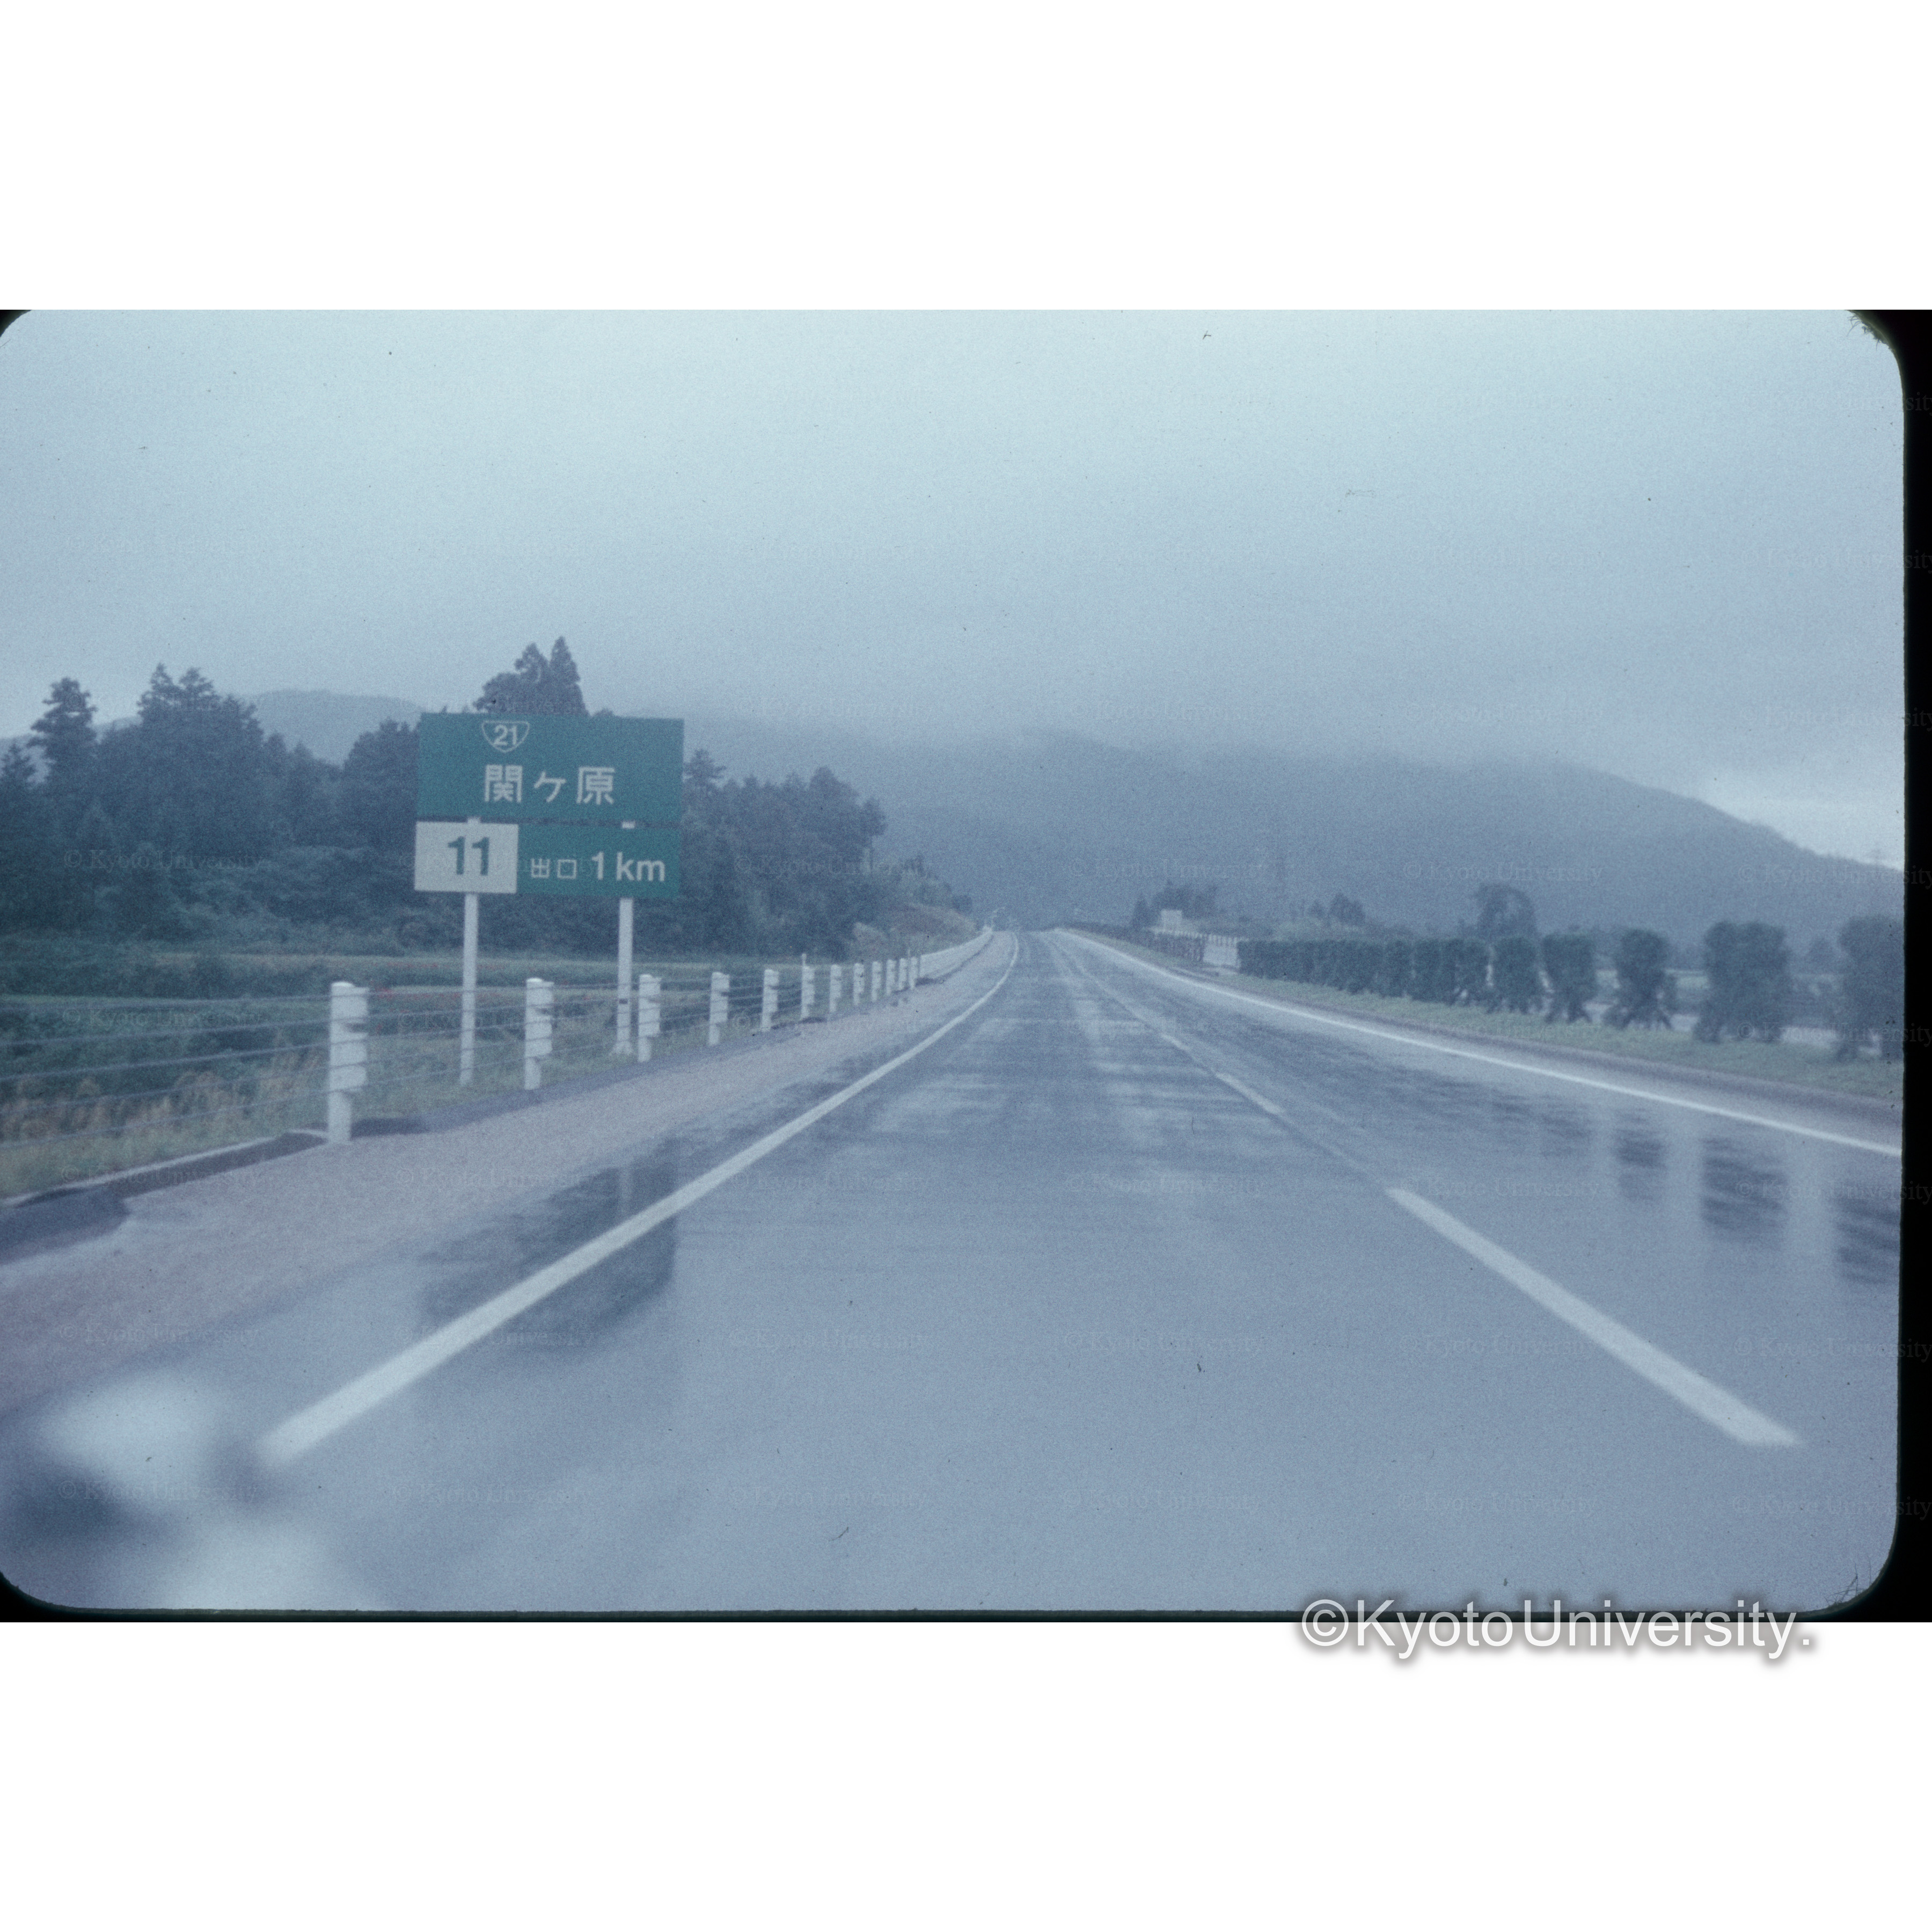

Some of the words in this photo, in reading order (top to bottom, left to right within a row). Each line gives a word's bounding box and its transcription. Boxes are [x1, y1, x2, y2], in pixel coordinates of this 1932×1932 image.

[494, 724, 517, 745] 21
[448, 837, 489, 876] 11
[531, 858, 576, 879] 出口
